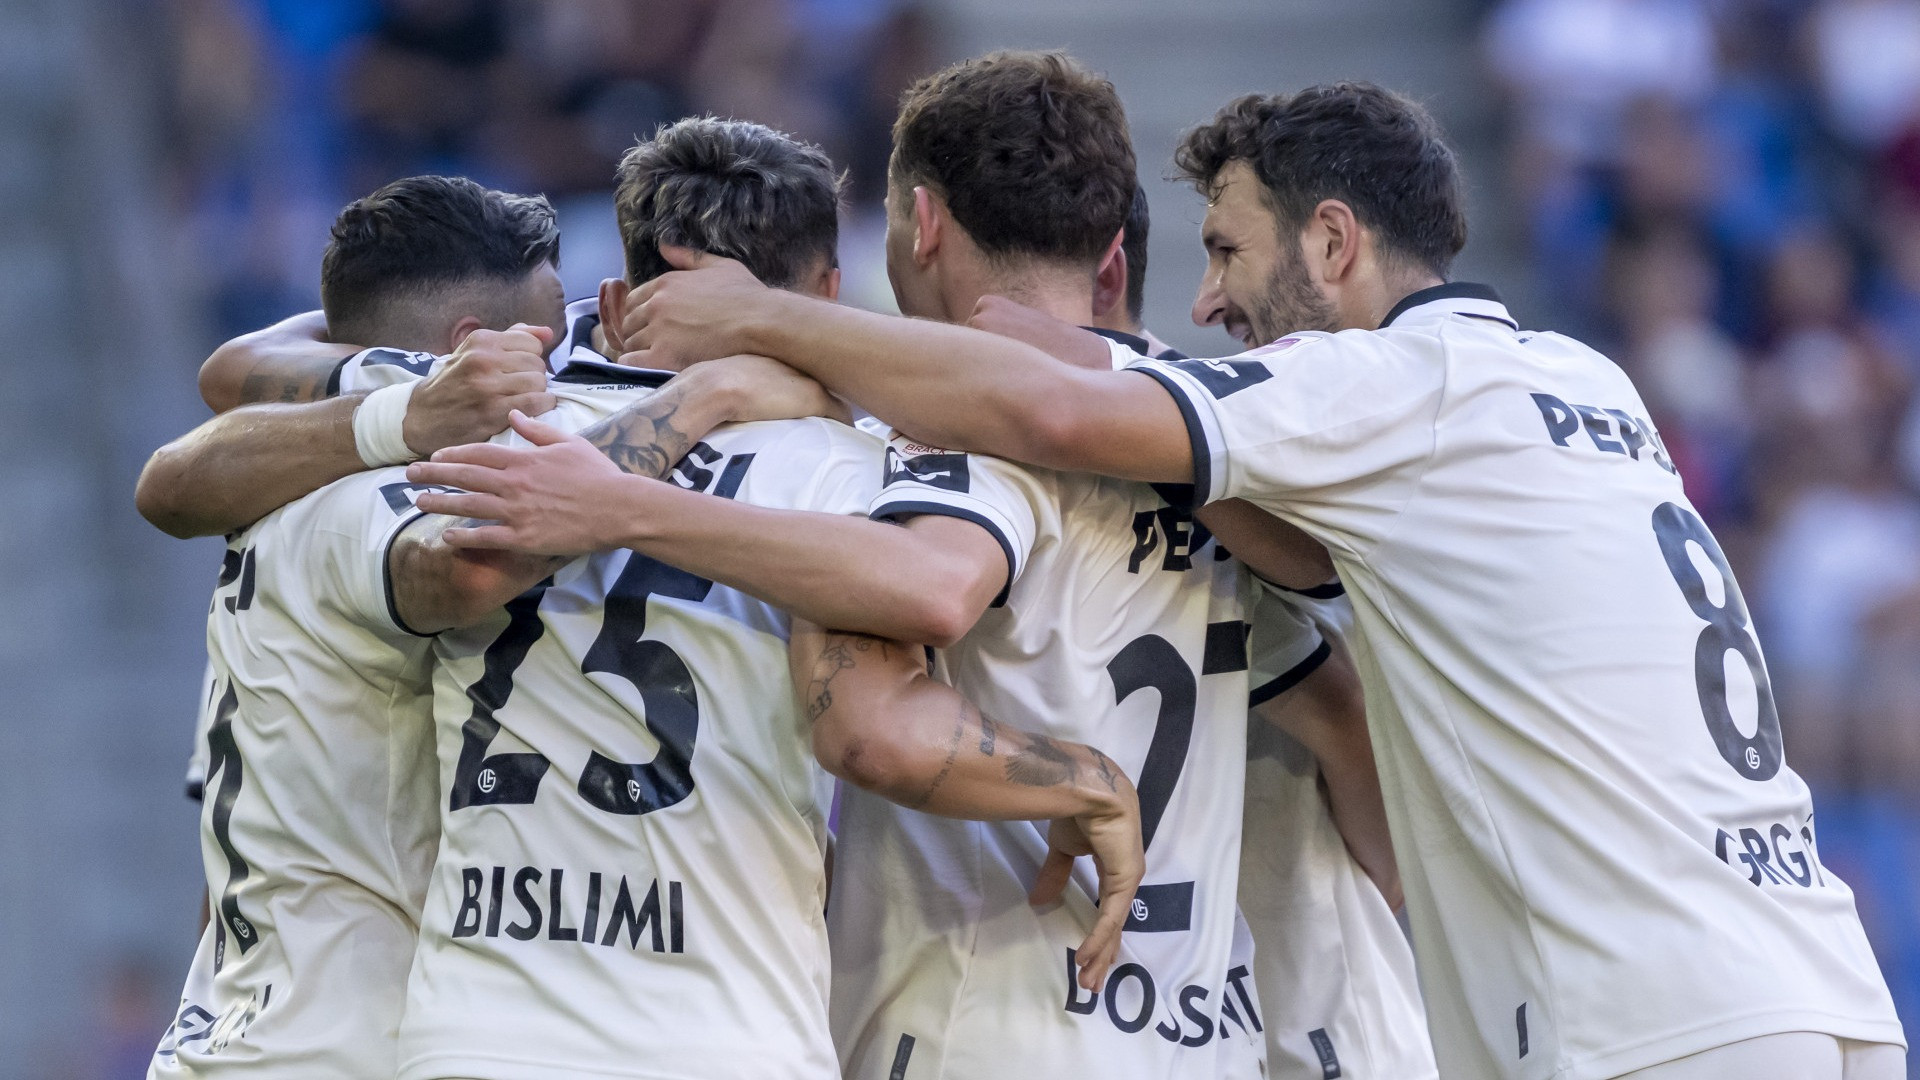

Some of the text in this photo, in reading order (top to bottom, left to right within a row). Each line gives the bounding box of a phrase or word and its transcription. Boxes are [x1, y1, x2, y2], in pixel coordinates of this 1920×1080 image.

[450, 550, 714, 815] 25
[1651, 501, 1783, 782] 8
[451, 866, 684, 954] BISLIMI
